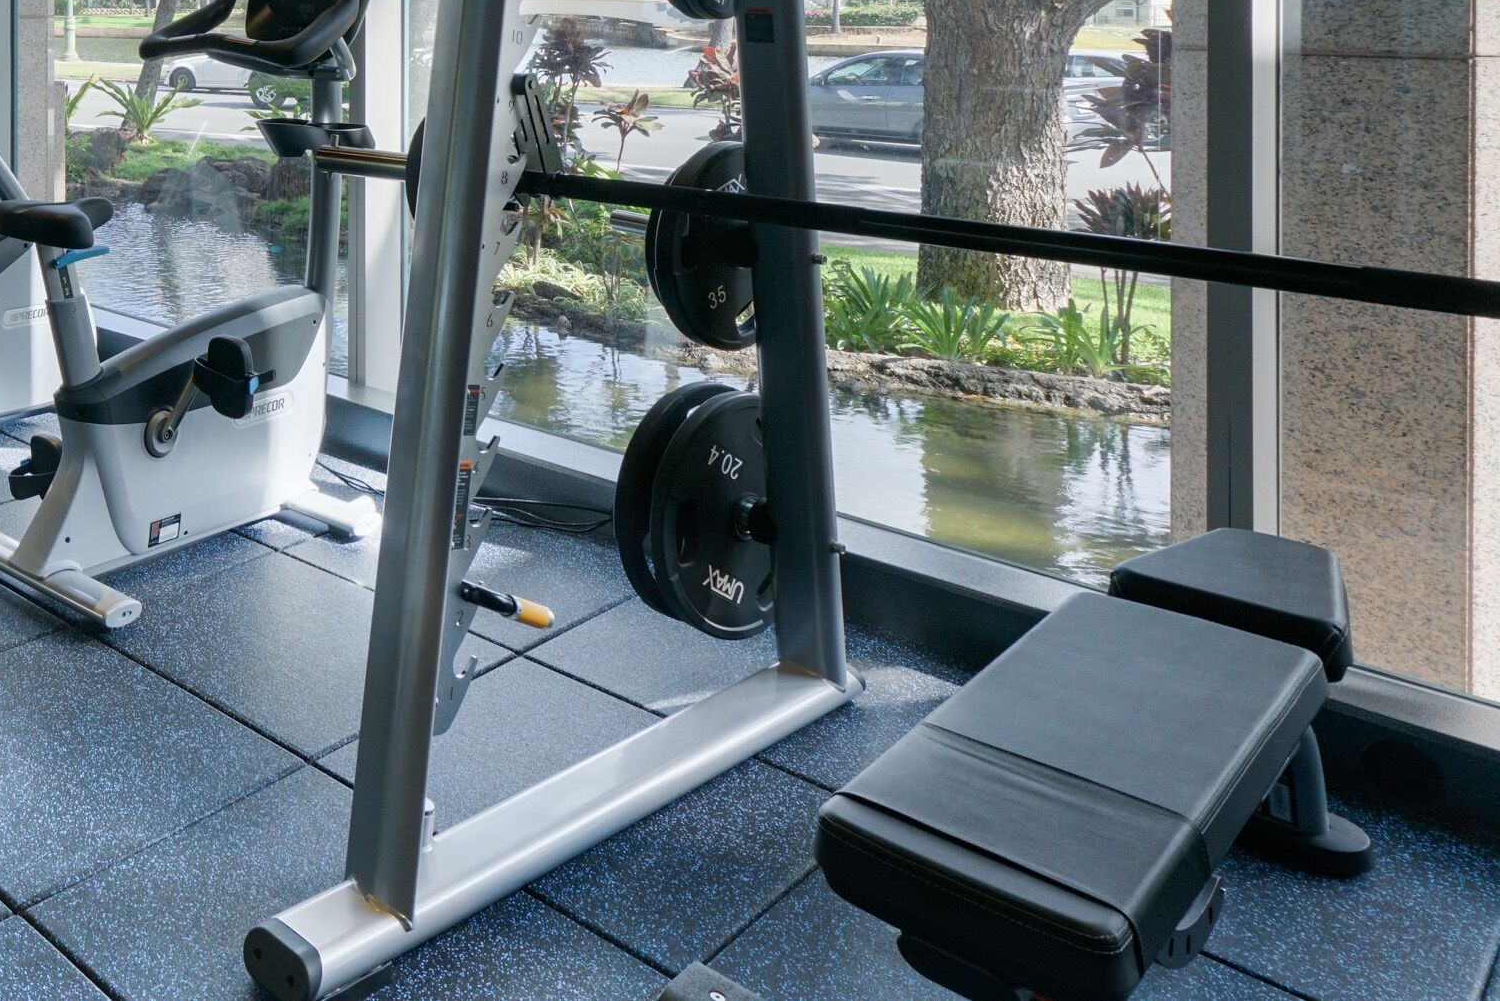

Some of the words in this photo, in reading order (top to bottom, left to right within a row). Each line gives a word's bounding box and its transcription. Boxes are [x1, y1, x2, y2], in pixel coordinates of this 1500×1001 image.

[512, 29, 523, 45] 10
[501, 171, 508, 186] 8
[494, 241, 501, 256] 7
[708, 285, 727, 309] 35
[486, 313, 493, 328] 6
[708, 445, 743, 479] 20.4
[702, 564, 745, 604] UMAX
